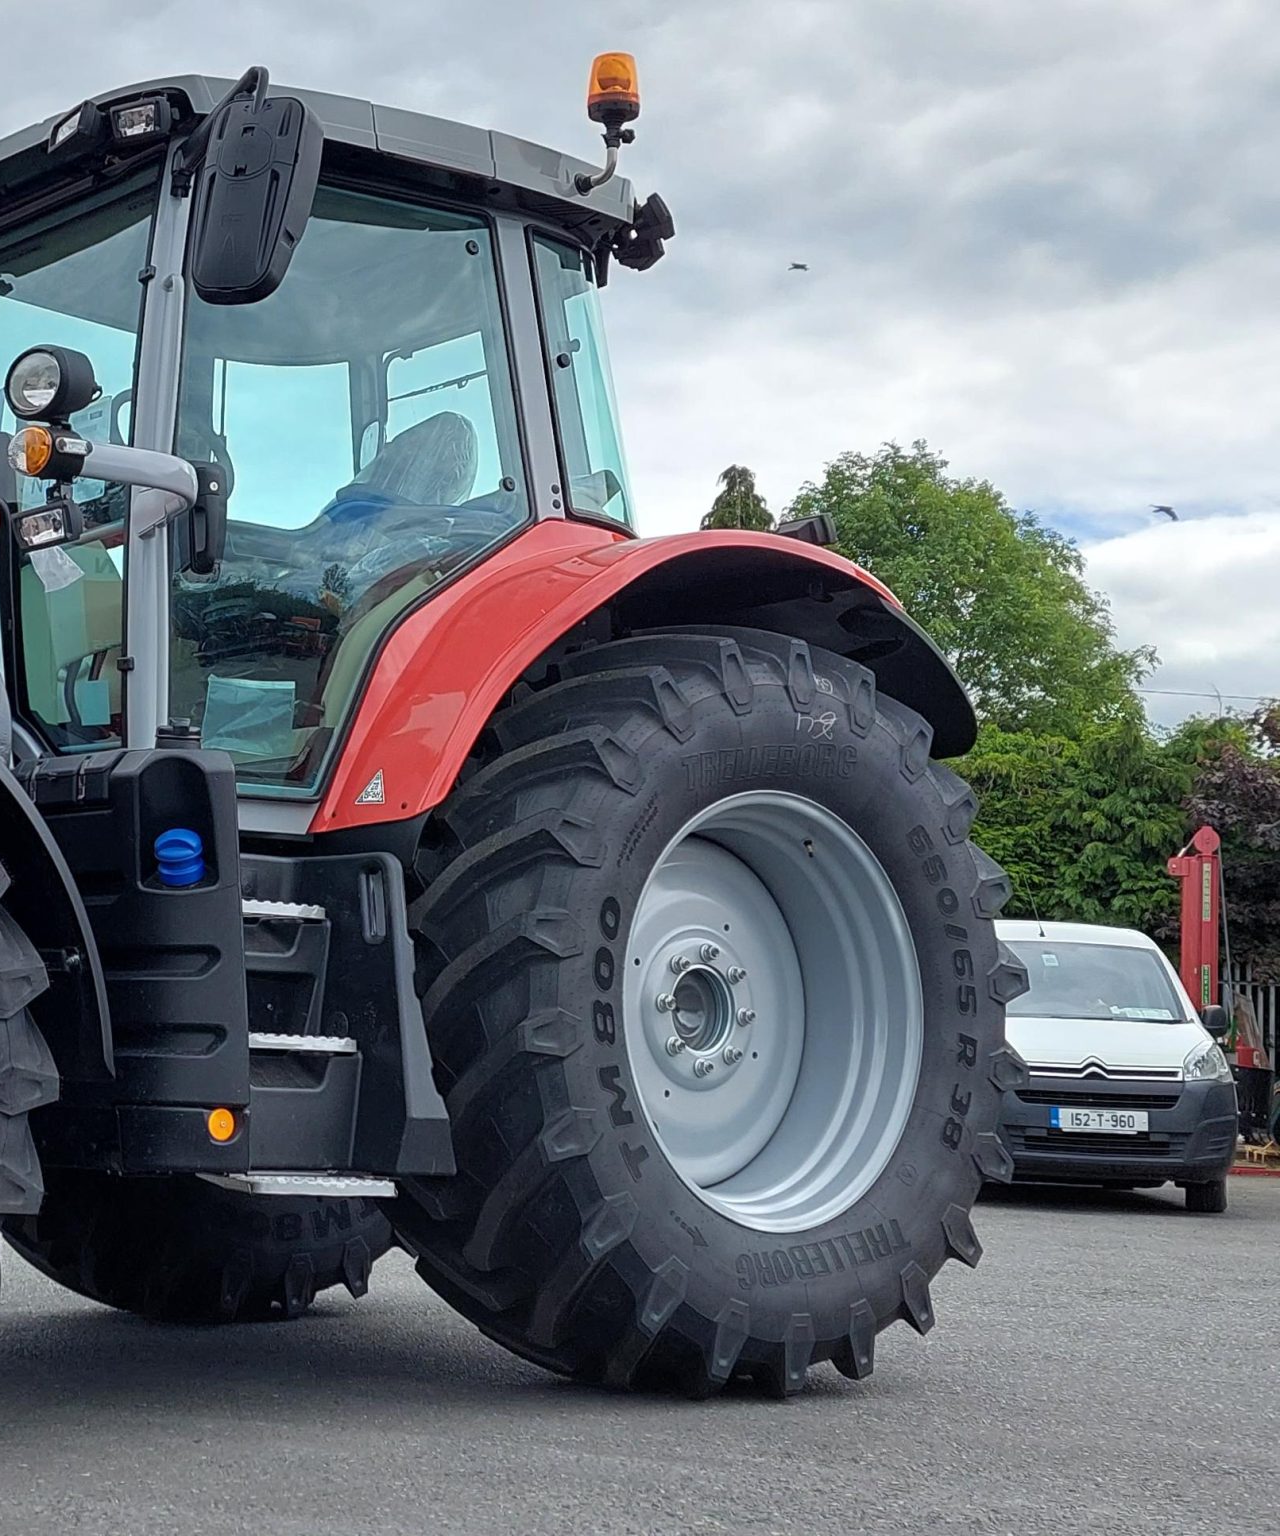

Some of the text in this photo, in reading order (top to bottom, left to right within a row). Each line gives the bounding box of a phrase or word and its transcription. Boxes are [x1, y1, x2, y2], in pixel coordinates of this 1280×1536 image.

[681, 743, 858, 791] TRELLEBORG
[907, 825, 977, 1018] 650/65
[593, 896, 649, 1183] TM800
[1070, 1112, 1135, 1128] 152-T-960
[735, 1218, 912, 1291] TRELLEBORG
